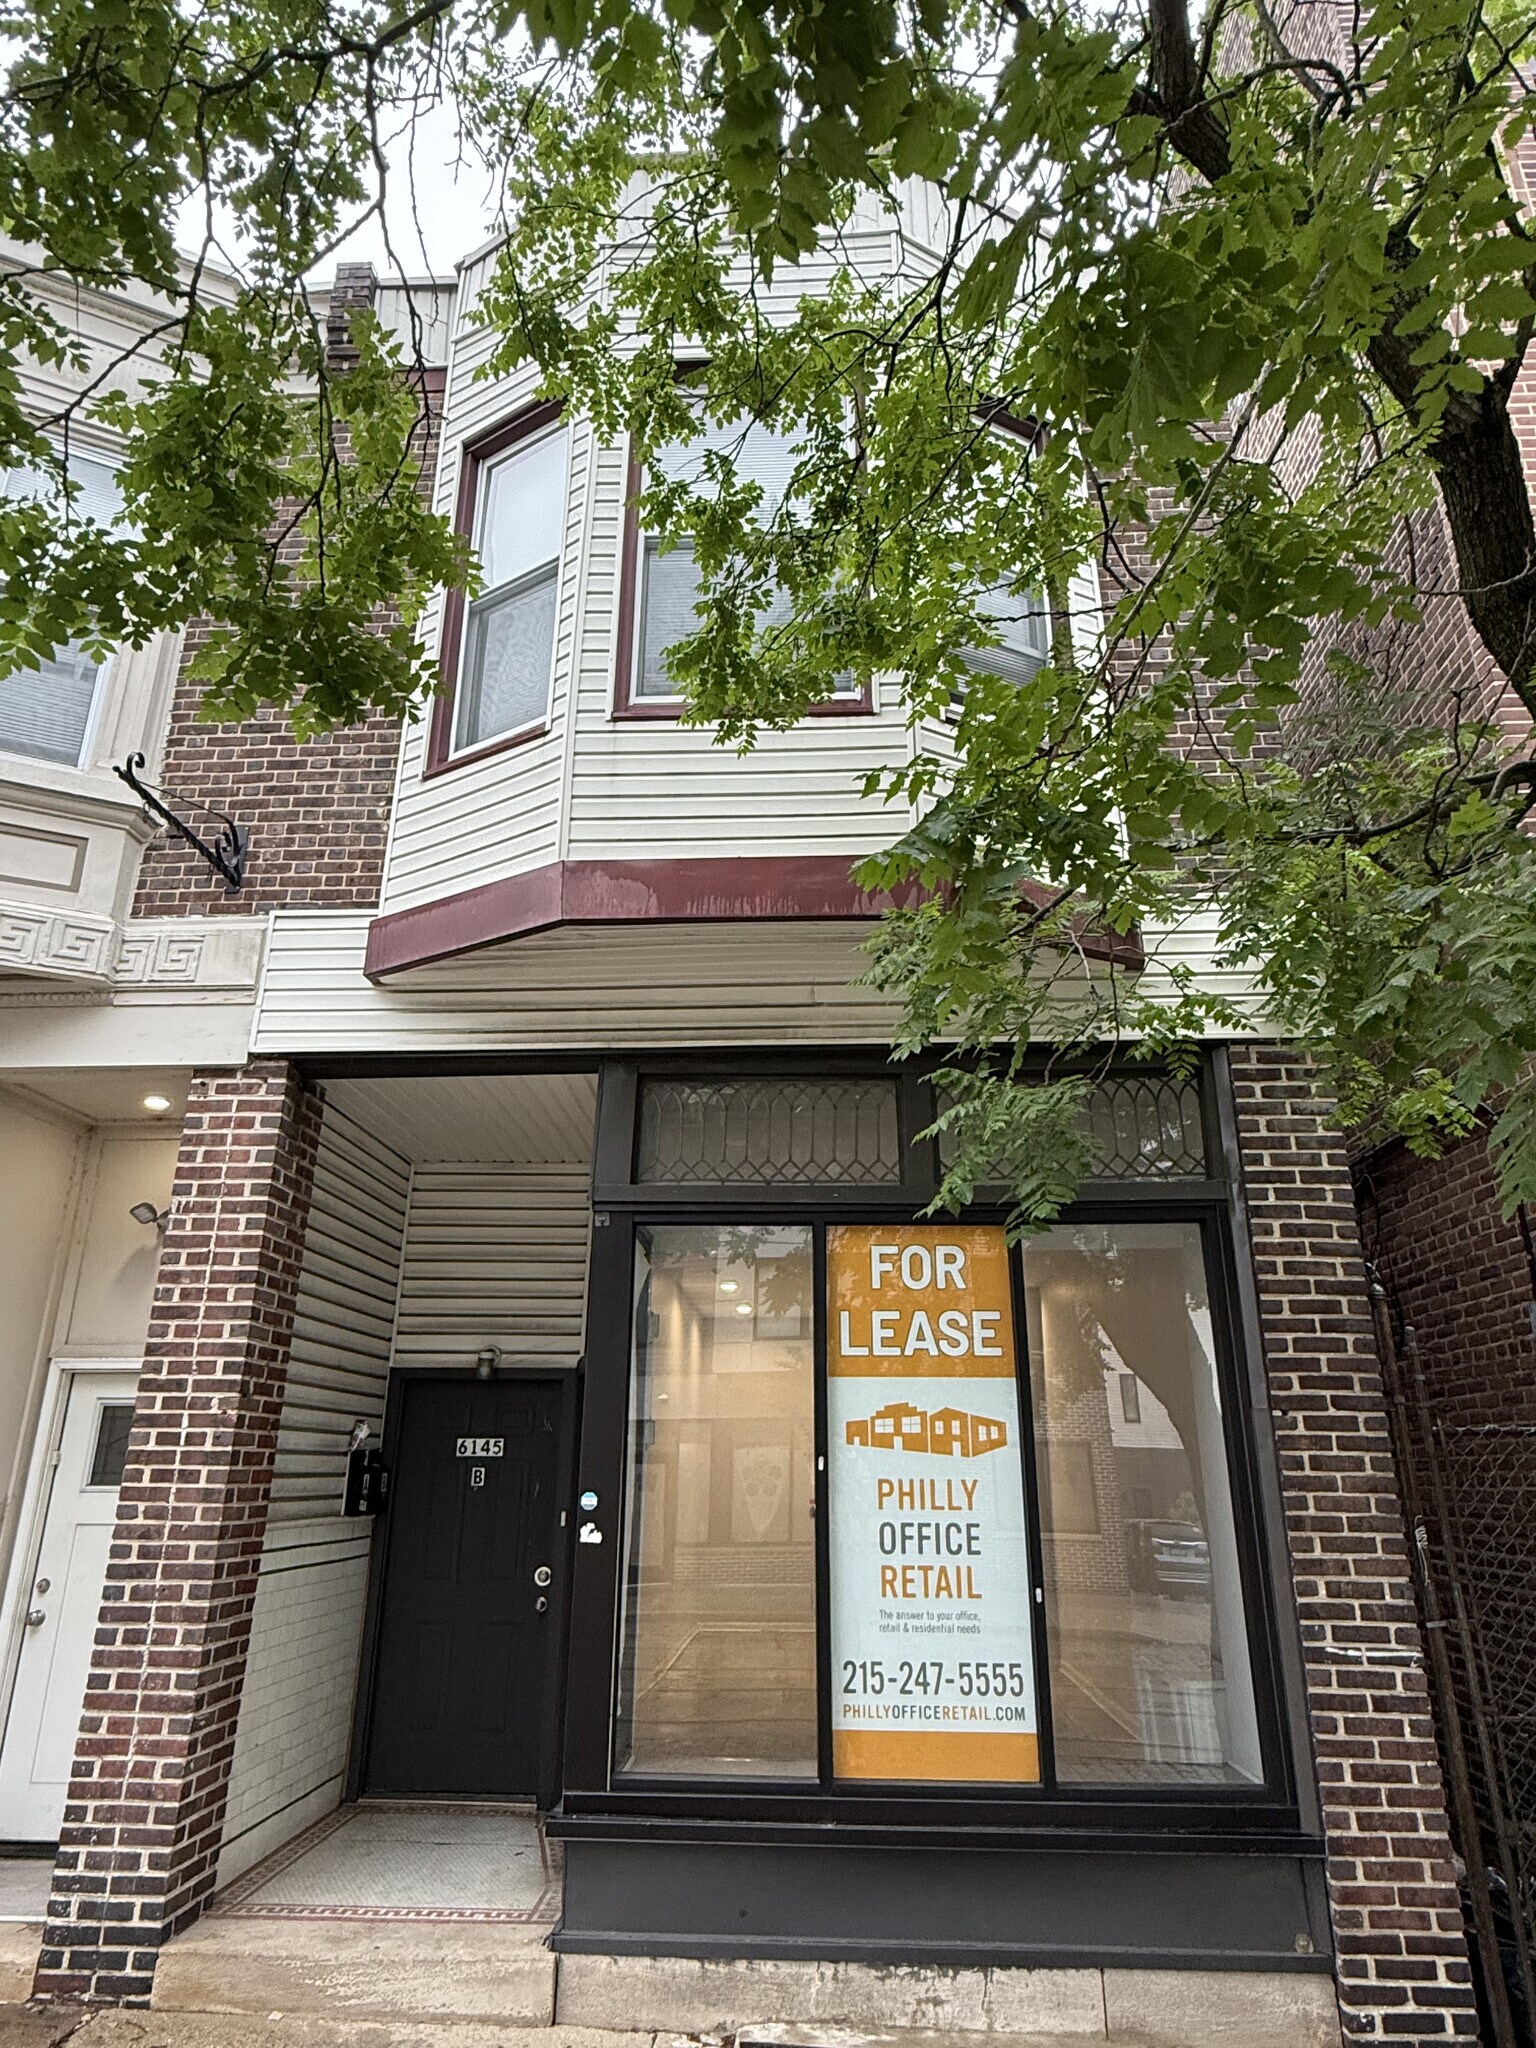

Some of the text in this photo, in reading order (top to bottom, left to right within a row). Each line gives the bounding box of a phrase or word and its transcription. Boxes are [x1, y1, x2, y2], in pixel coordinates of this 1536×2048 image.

[870, 1244, 967, 1290] FOR
[839, 1310, 1003, 1357] LEASE
[458, 1440, 502, 1455] 6145
[473, 1469, 483, 1484] B
[877, 1478, 979, 1511] PHILLY
[878, 1522, 982, 1556] OFFICE
[880, 1565, 983, 1599] RETAIL
[879, 1609, 981, 1623] The answer to your office,
[879, 1622, 982, 1634] retail & residential needs
[842, 1660, 1024, 1697] 215-247-5555
[842, 1703, 1026, 1721] PHILLYOFFICERETAIL.COM
